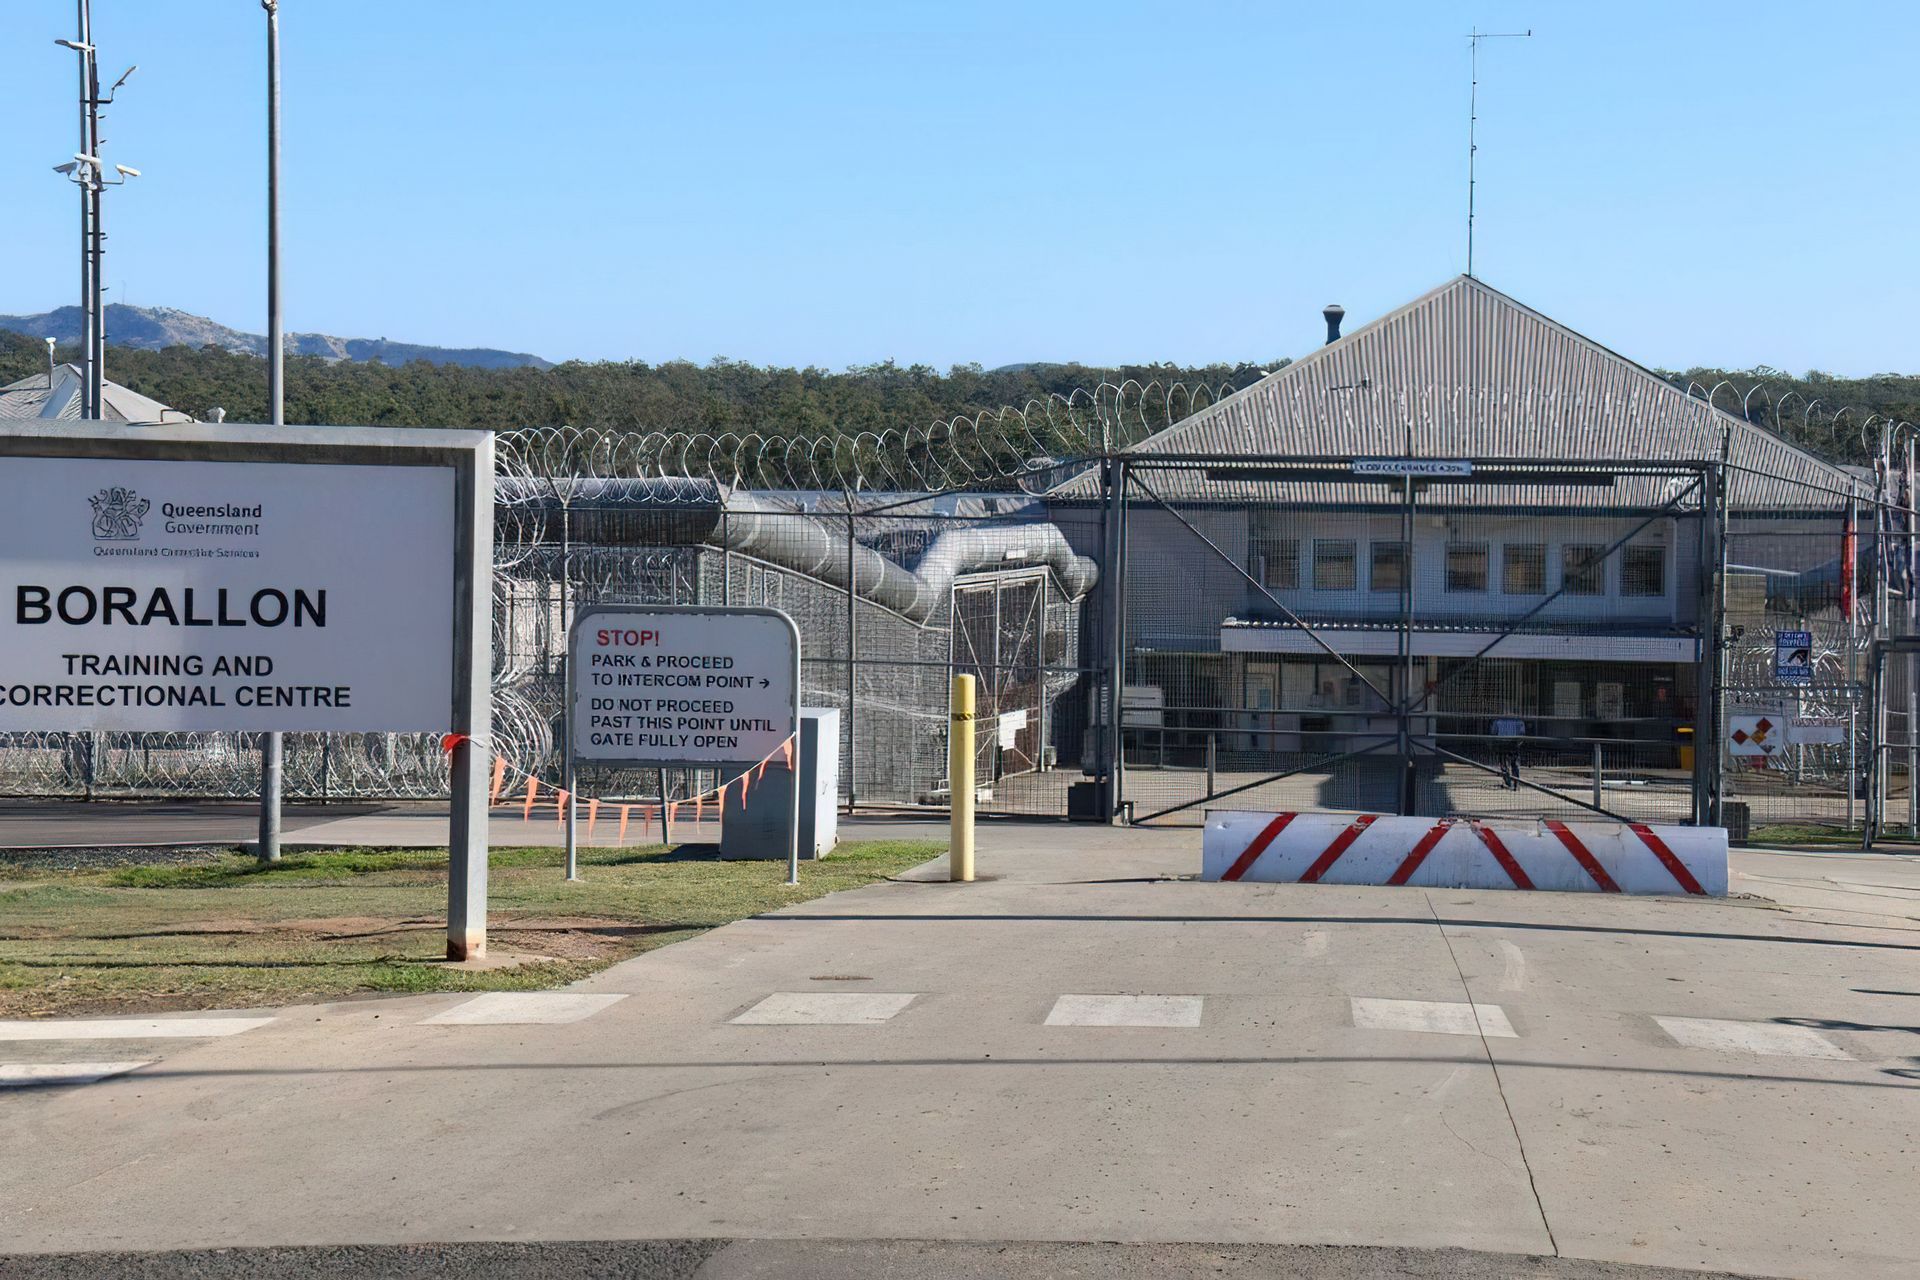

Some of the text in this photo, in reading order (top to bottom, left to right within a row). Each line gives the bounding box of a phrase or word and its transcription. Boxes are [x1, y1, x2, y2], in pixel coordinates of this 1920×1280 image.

[162, 502, 262, 519] Queensland
[164, 521, 260, 536] Government
[16, 585, 327, 627] BORALLON
[596, 629, 660, 647] STOP!
[62, 654, 274, 677] TRAINING AND
[591, 654, 734, 669] PARK & PROCEED
[591, 673, 754, 689] TO INTERCOM POINT
[235, 686, 351, 708] CENTRE
[591, 698, 734, 714] DO NOT PROCEED
[591, 715, 776, 732] PAST THIS POINT UNTIL
[590, 733, 738, 748] GATE FULLY OPEN
